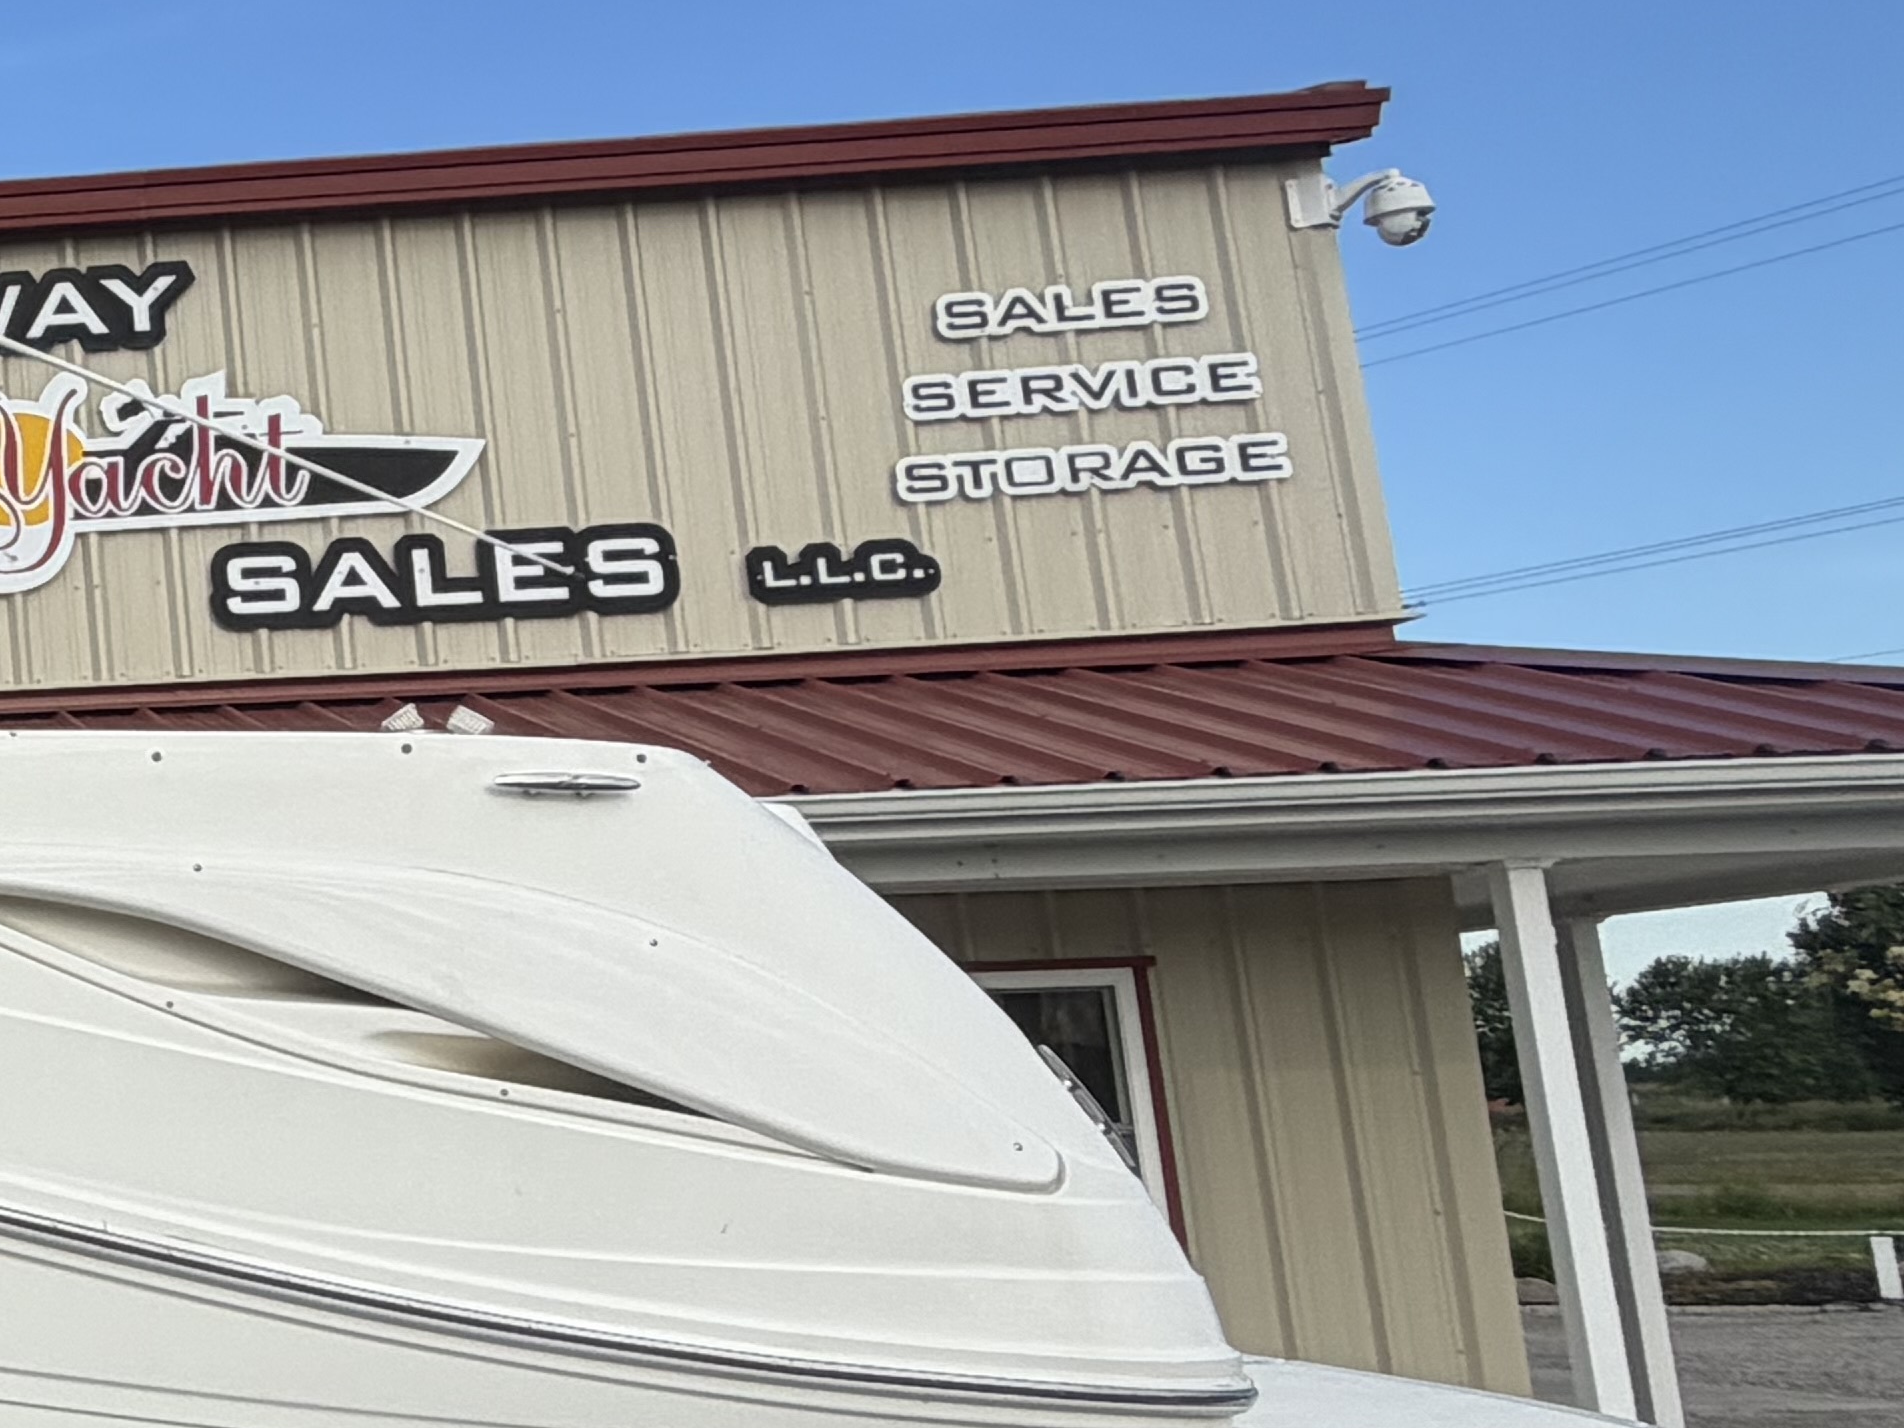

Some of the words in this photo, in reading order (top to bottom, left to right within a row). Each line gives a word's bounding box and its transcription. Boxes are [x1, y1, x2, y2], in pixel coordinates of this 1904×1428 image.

[944, 281, 1201, 331] SALES
[910, 359, 1256, 413] SERVICE
[904, 440, 1286, 494] STORAGE
[226, 537, 662, 615] SALES
[762, 553, 927, 589] L.L.C.
